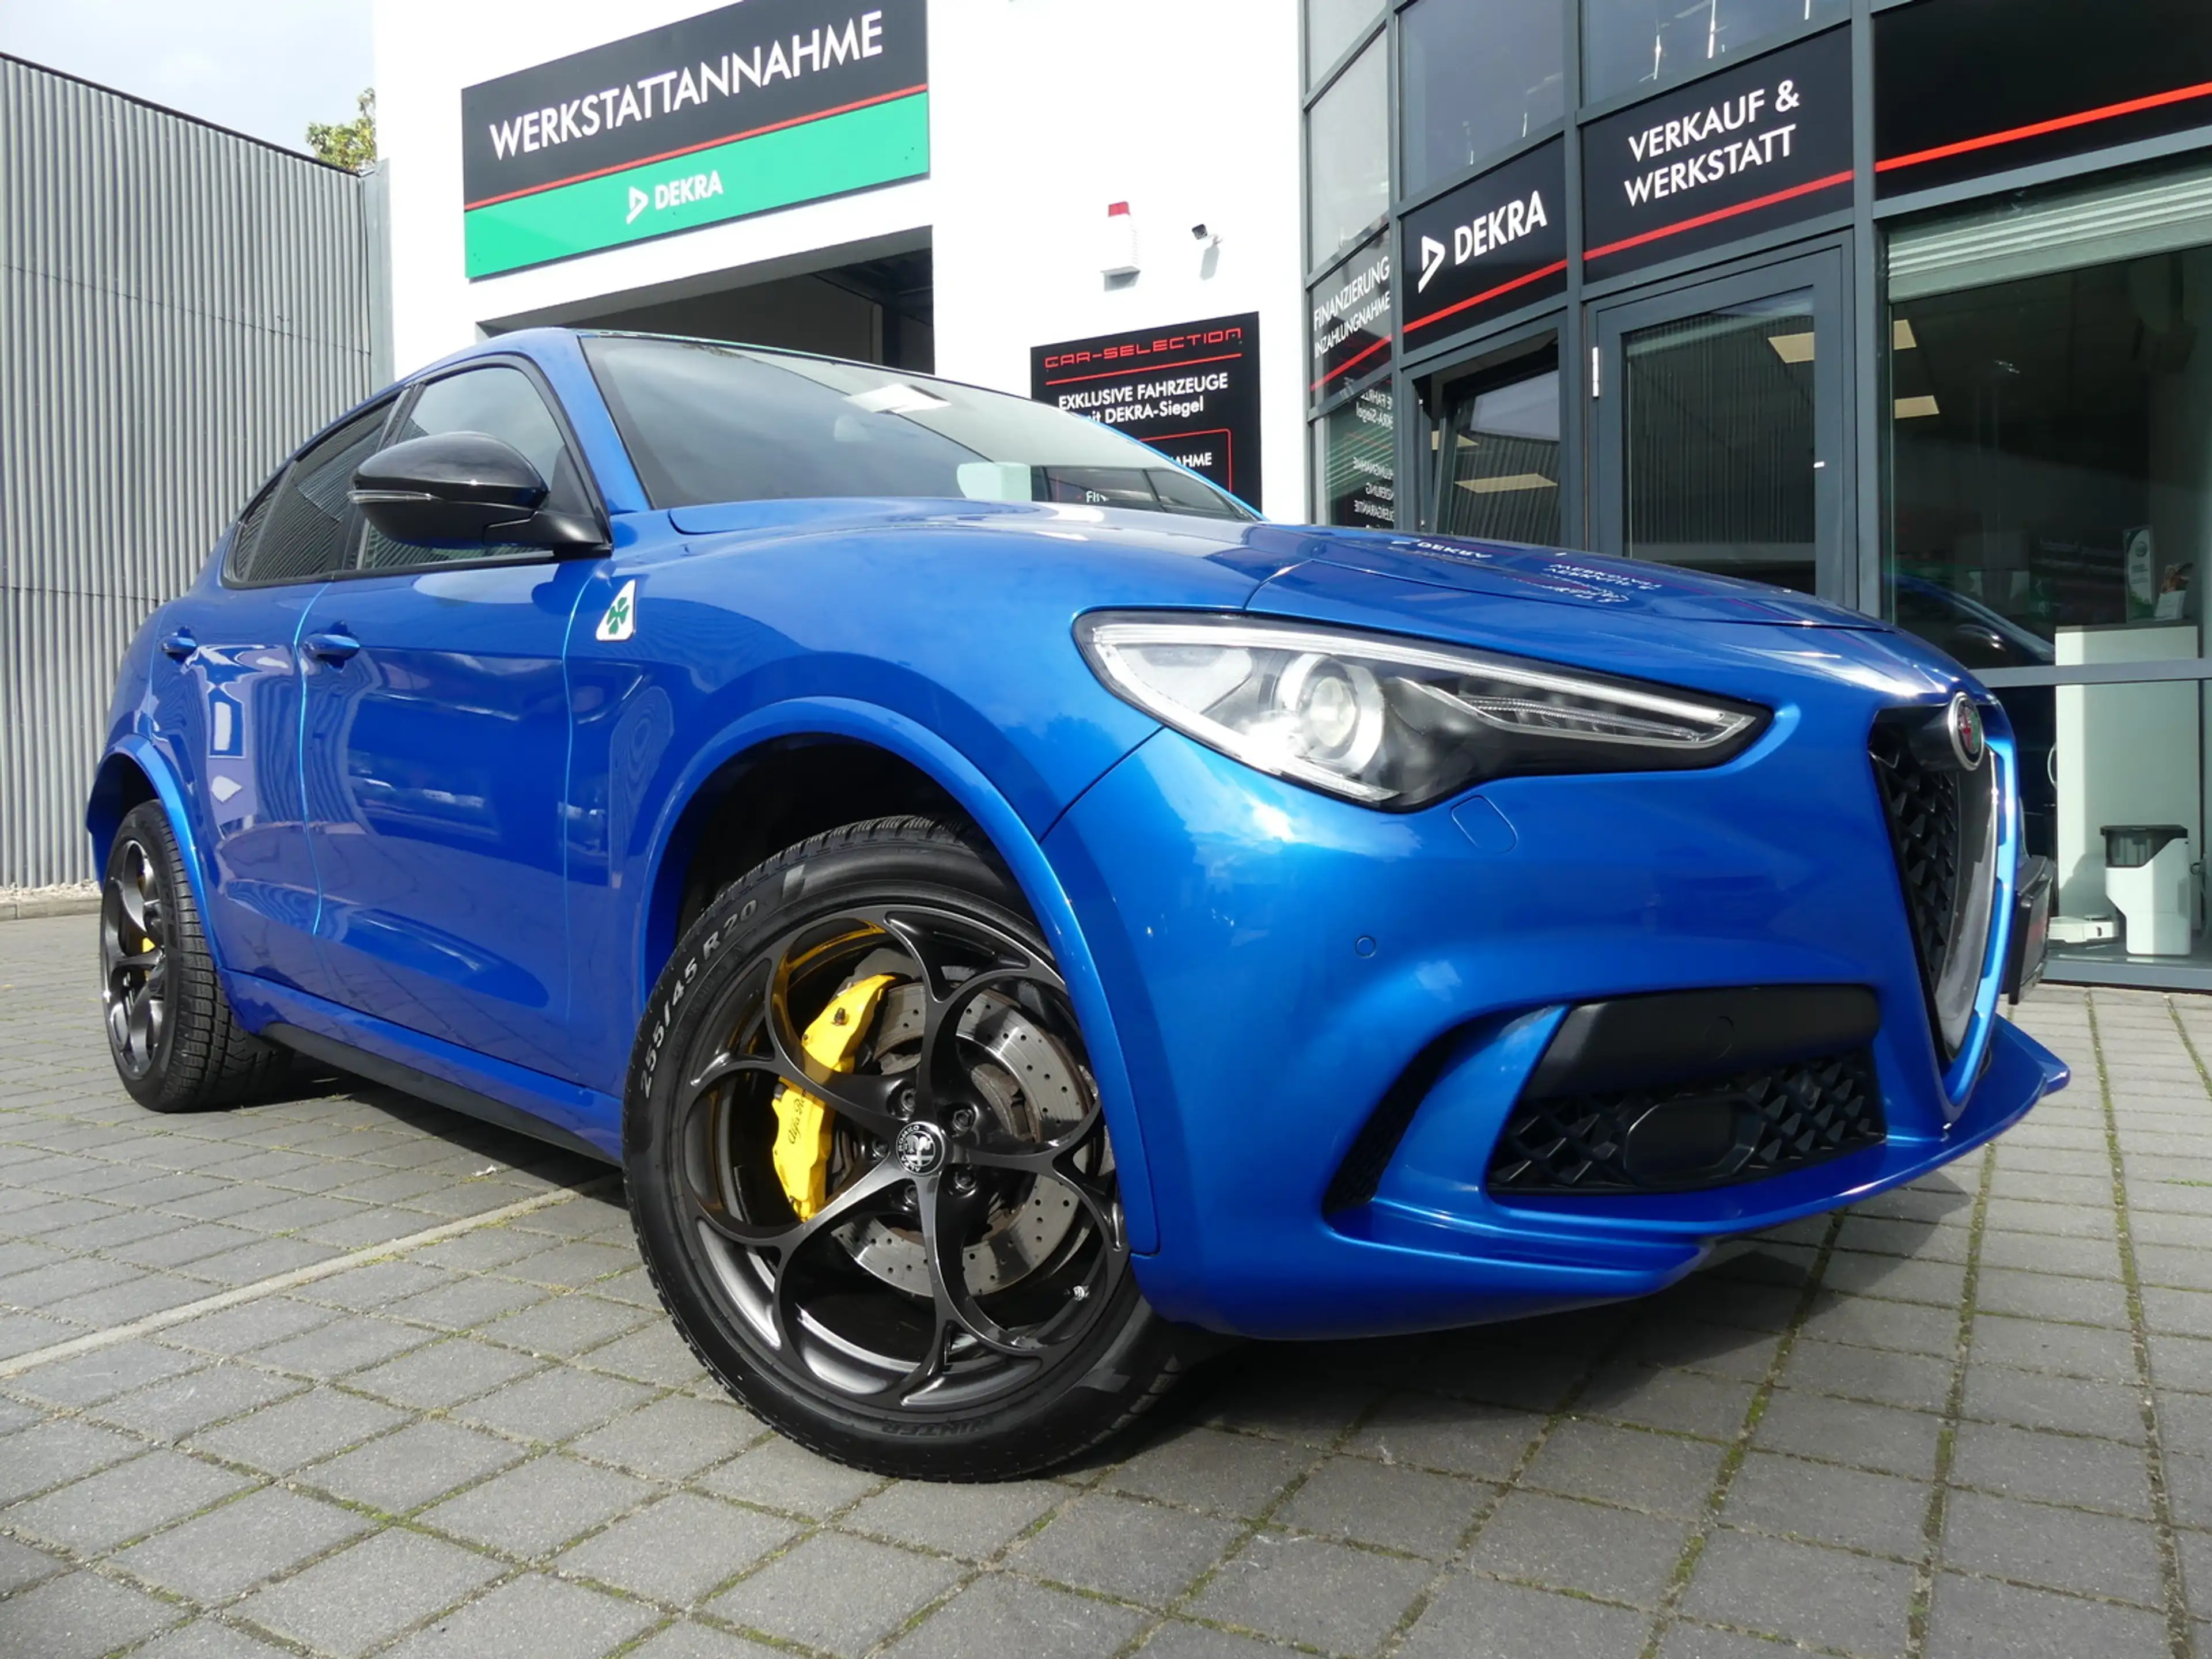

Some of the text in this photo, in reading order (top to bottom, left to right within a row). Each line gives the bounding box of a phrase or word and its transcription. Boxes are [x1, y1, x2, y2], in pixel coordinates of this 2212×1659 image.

[488, 10, 883, 161] WERKSTATTANNAHME
[1628, 79, 1800, 162] VERKAUF &
[654, 170, 724, 211] DEKRA
[1624, 124, 1797, 207] WERKSTATT
[1454, 190, 1548, 266] DEKRA
[1314, 256, 1390, 331] FINANZIERUNG
[1315, 290, 1391, 358] INZAHLUNGNAHME
[1044, 328, 1241, 369] CAR-SELECTION
[1059, 373, 1228, 411] EXKLUSIVE FAHRZEUGE
[1105, 396, 1204, 423] DEKRA-Siegel
[641, 957, 698, 1098] 255/45
